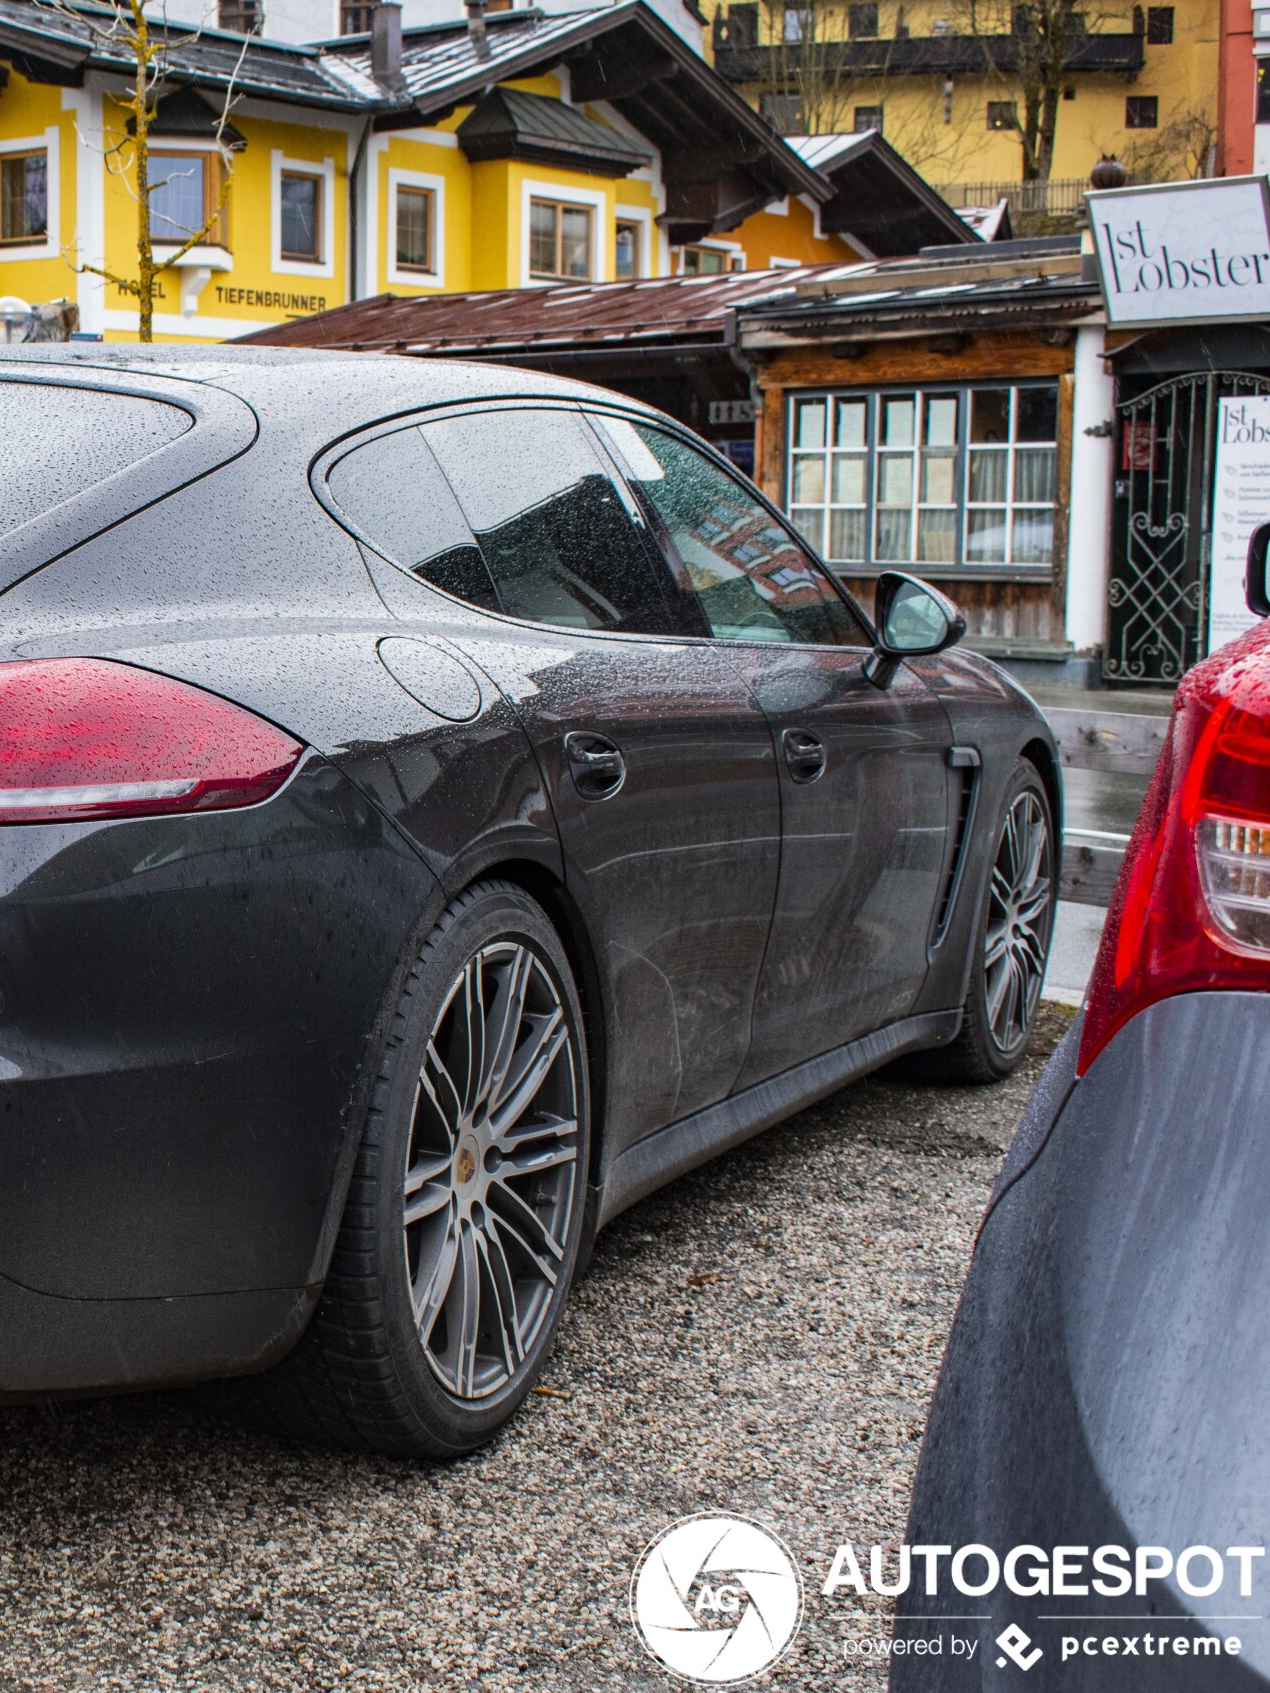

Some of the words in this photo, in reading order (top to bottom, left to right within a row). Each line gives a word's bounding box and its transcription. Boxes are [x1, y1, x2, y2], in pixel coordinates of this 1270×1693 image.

[1105, 244, 1270, 294] Lobster
[118, 279, 166, 299] HOEL
[215, 286, 326, 312] TIEFENBRUNNER
